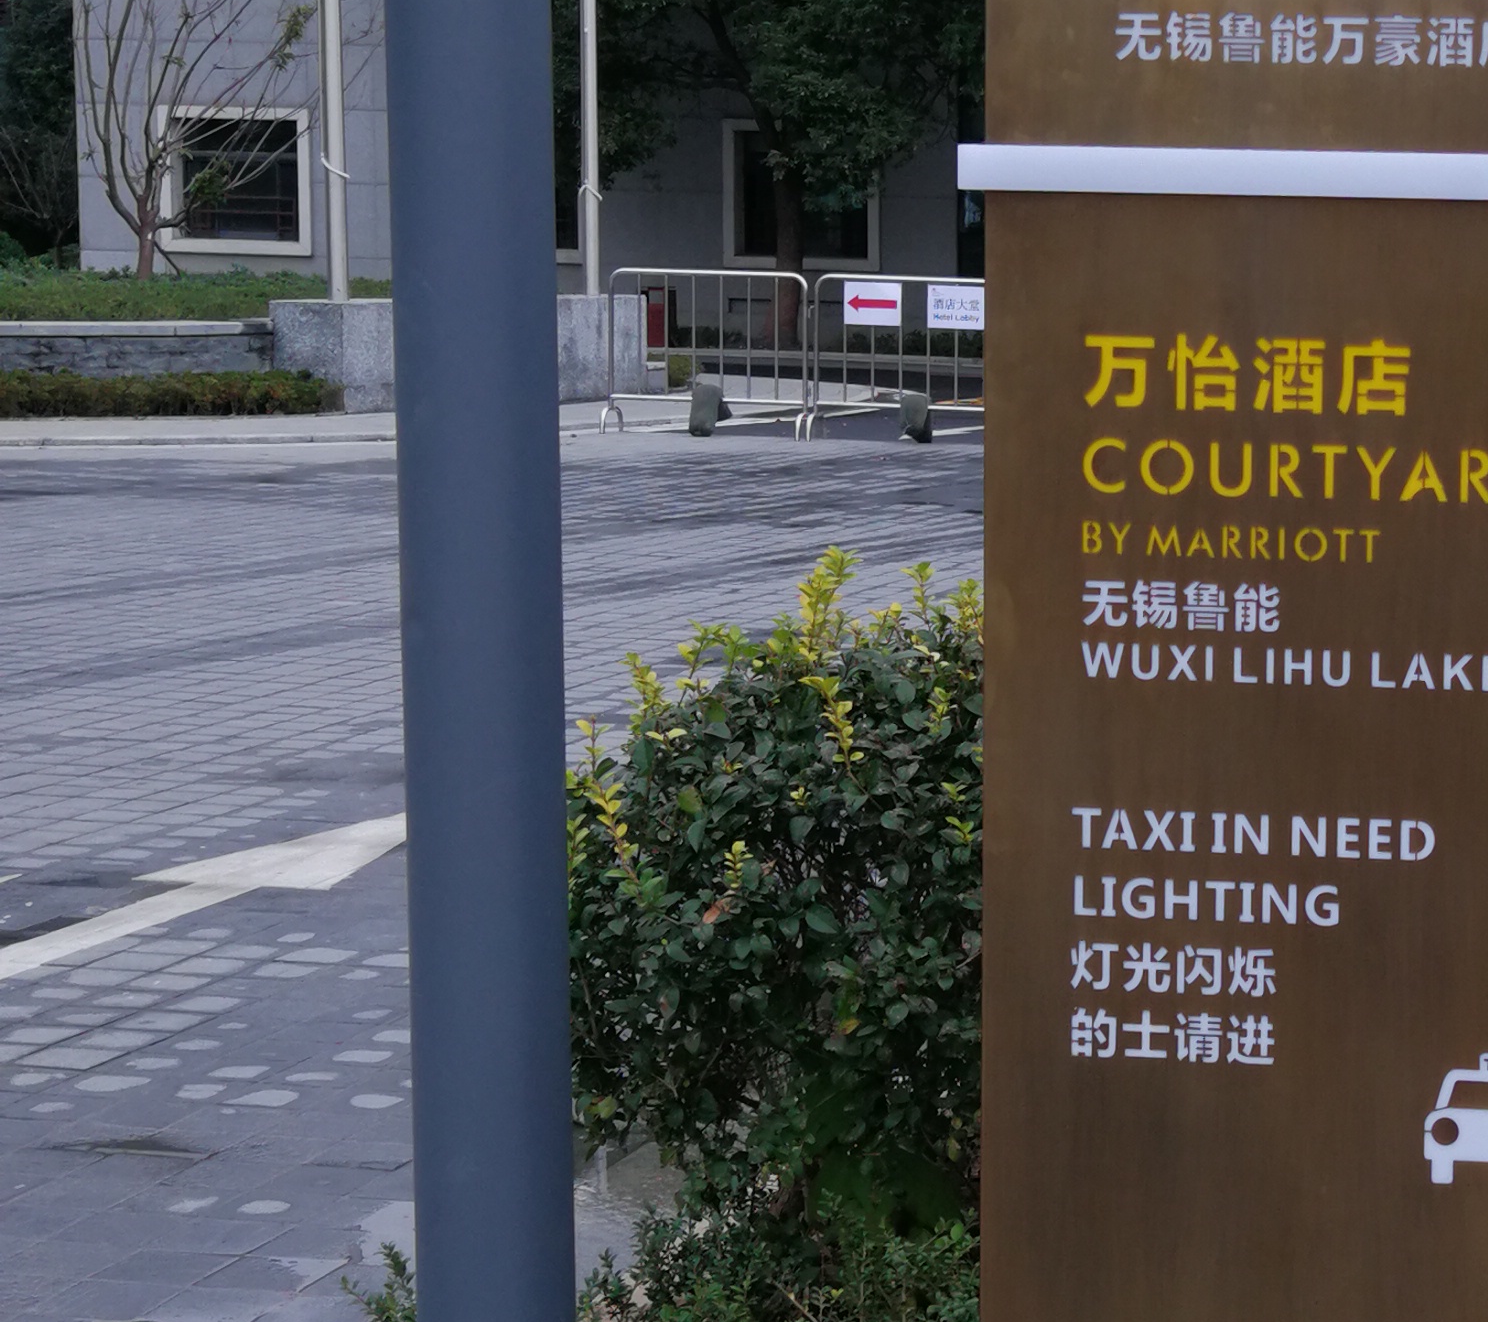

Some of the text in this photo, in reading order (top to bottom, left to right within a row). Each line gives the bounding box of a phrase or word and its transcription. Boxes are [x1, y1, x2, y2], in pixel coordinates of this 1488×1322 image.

[933, 313, 980, 323] Hotel Lobby
[1084, 333, 1411, 416] 万怡酒店
[1081, 520, 1381, 564] BY MARRIOTT
[1082, 579, 1281, 633] 无锡鲁能
[1081, 641, 1214, 682] WUXI
[1233, 646, 1351, 688] LIHU
[1071, 807, 1437, 862] TAXI IN NEED
[1073, 875, 1341, 927] LIGHTING
[1070, 940, 1277, 998] 灯光闪烁
[1070, 1007, 1276, 1066] 的士请进
